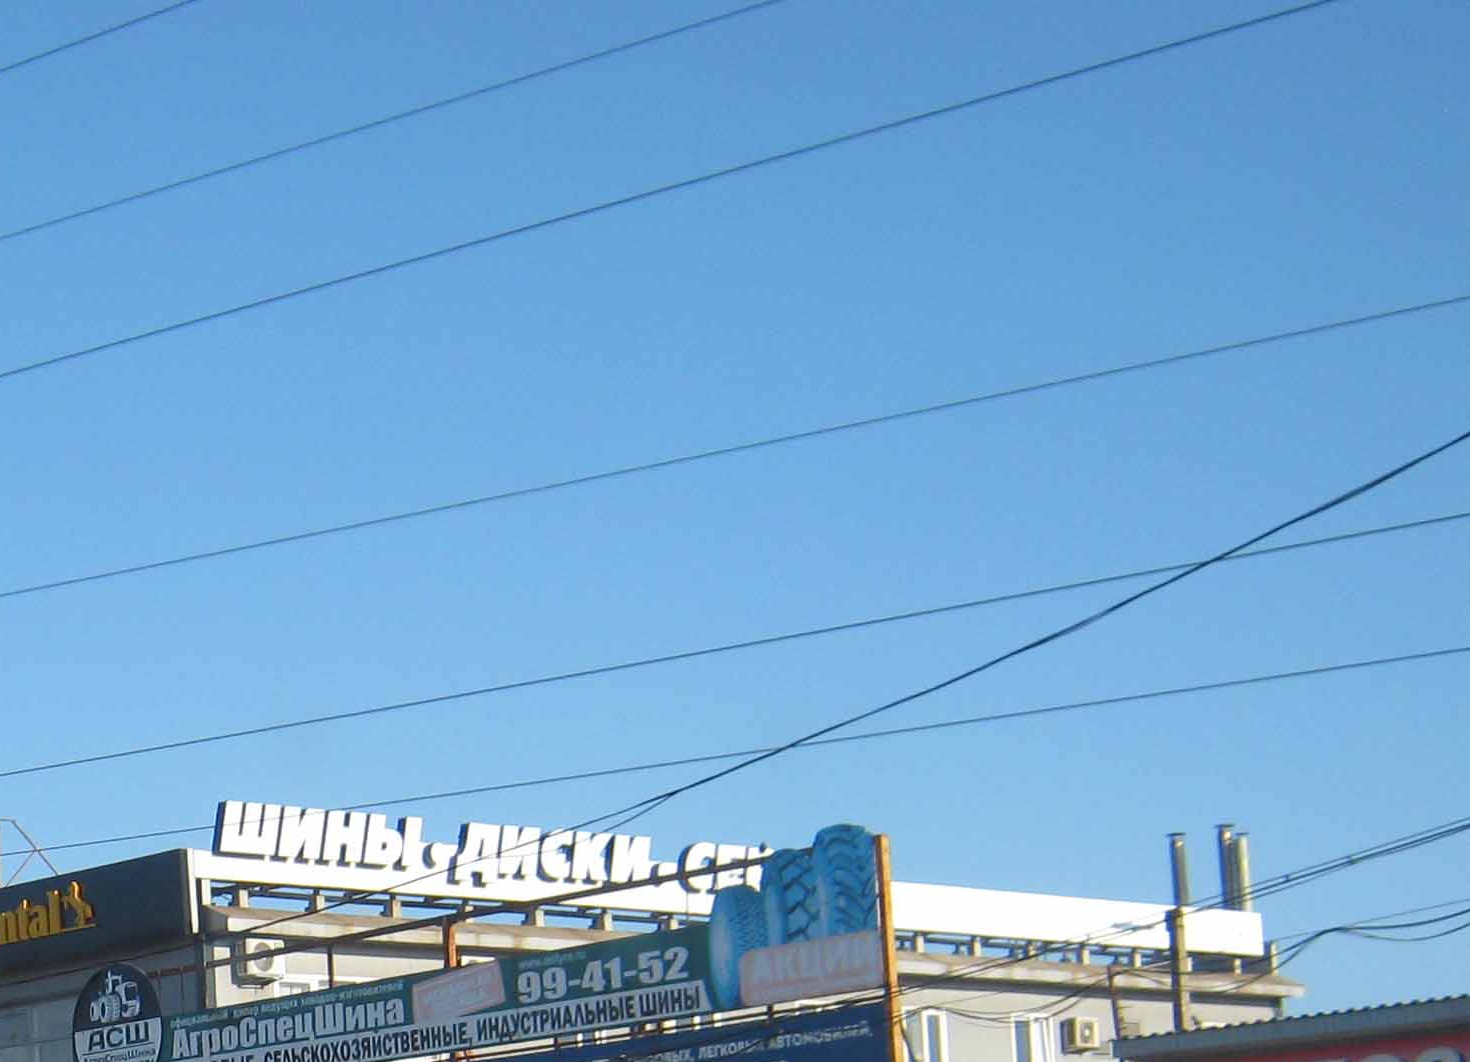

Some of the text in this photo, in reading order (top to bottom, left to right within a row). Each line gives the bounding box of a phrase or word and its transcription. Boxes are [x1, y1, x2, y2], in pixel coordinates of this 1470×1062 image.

[214, 800, 425, 872] ШИНЫ
[448, 822, 652, 888] ДИСКИ
[517, 946, 690, 1003] 99-41-52
[88, 1021, 150, 1052] АСШ
[171, 997, 405, 1060] АгроСпецШина
[476, 998, 636, 1042] ИНДУСТРИАЛЬНЫЕ
[639, 983, 701, 1016] ШИНЫ
